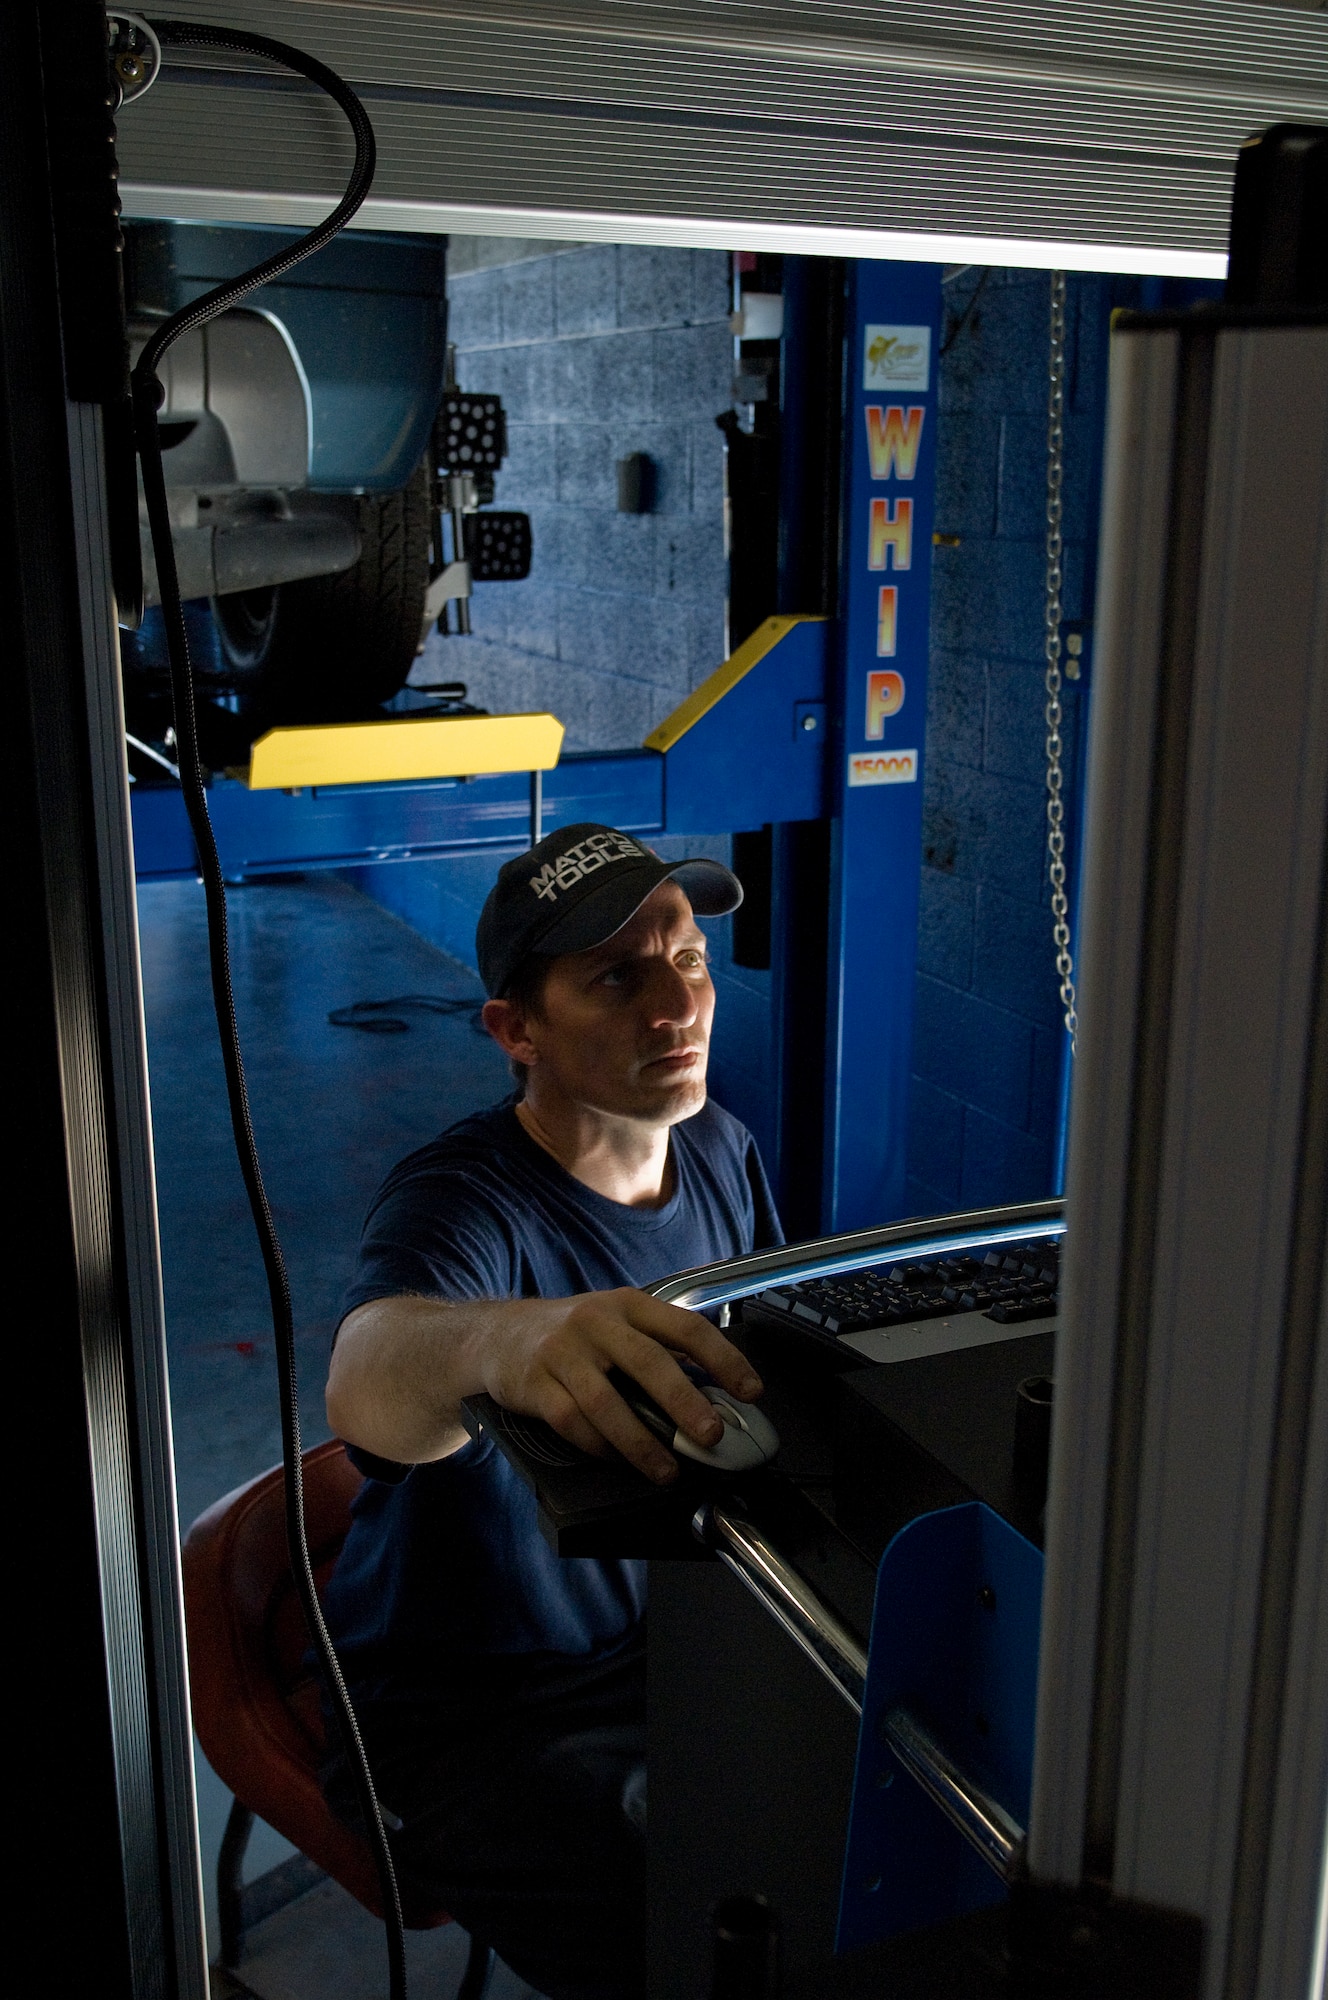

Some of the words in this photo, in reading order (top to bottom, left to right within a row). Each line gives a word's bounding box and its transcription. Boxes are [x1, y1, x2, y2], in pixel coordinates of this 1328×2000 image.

[864, 405, 926, 740] WHIP
[853, 756, 912, 780] 15000
[529, 832, 632, 894] MATCO
[538, 844, 645, 901] TOOLS
